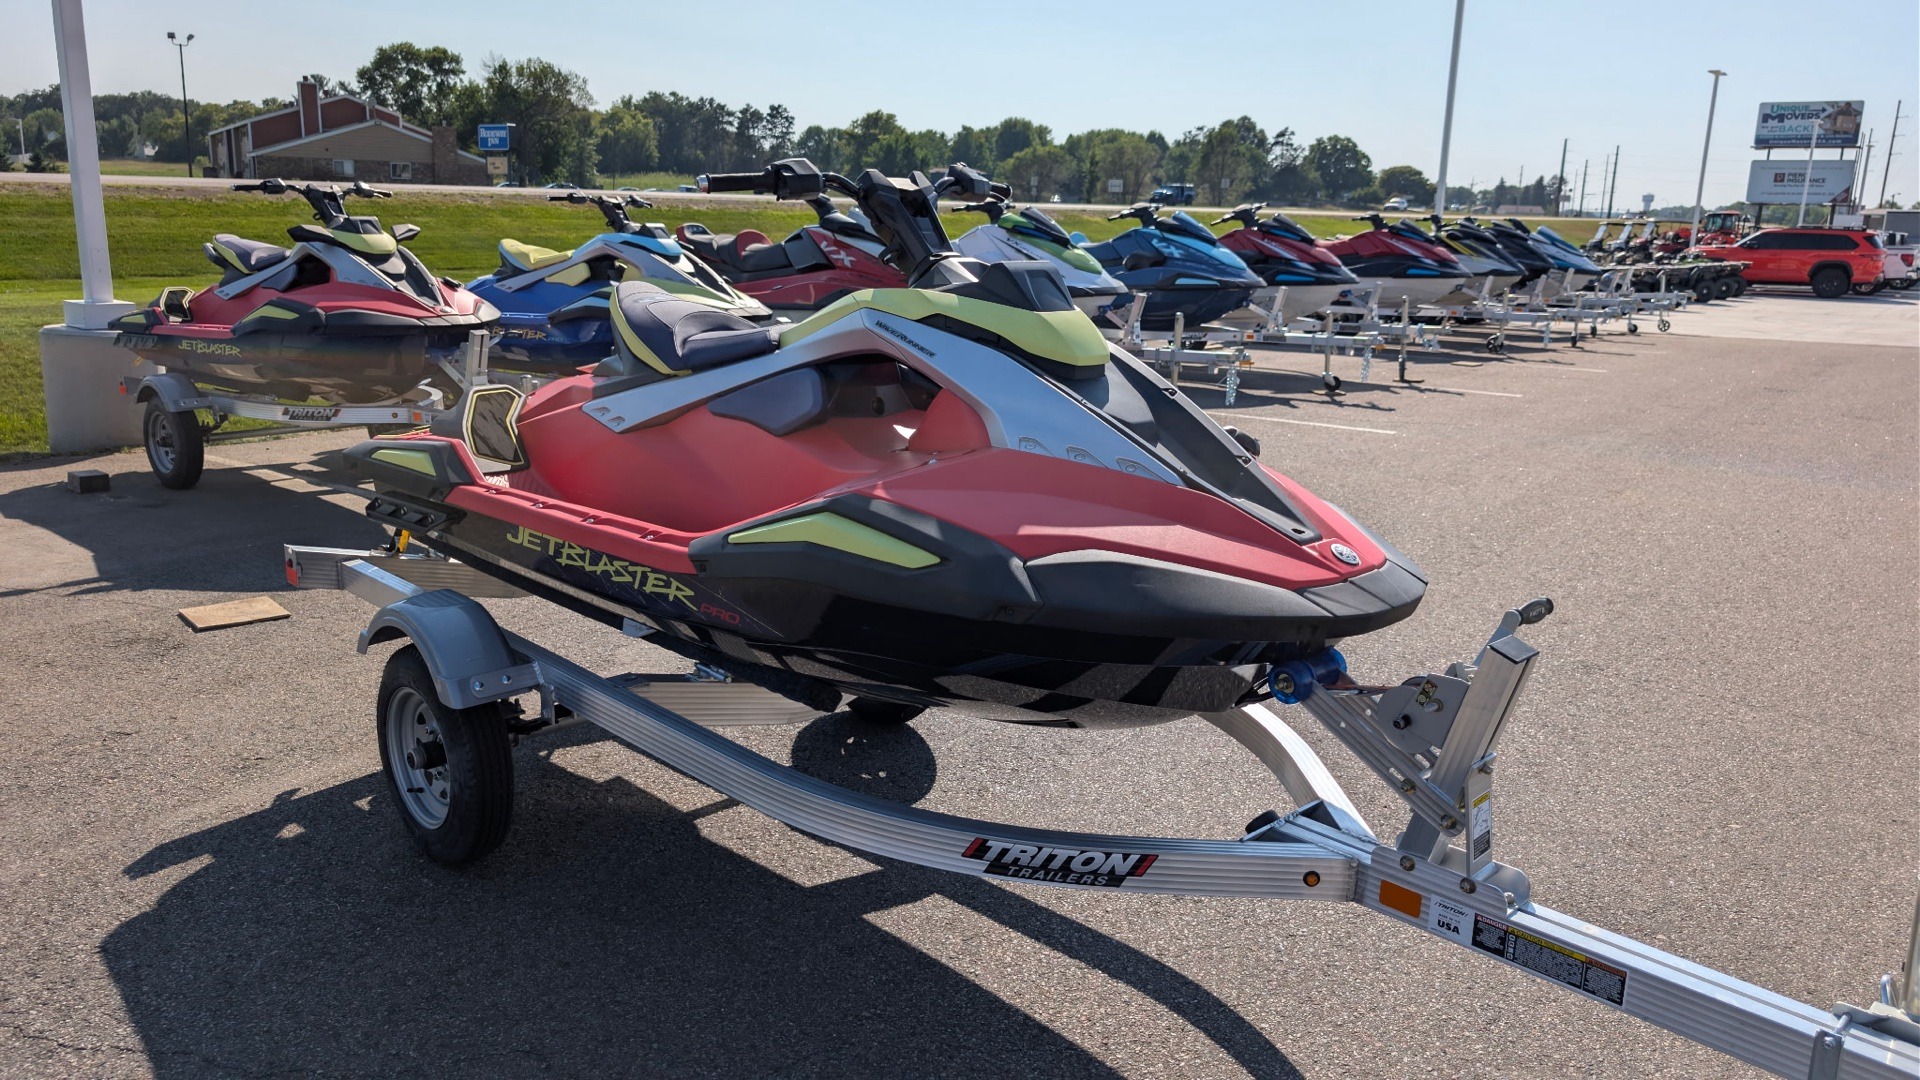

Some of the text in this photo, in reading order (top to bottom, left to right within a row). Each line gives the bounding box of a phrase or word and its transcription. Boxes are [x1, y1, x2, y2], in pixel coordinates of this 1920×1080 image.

[1762, 112, 1820, 123] MOVERS
[1771, 104, 1810, 114] UNIQUE
[820, 240, 857, 268] VX
[178, 339, 242, 357] JETBLASTER
[290, 408, 335, 417] TRITON
[506, 526, 741, 625] JETBLASTER PRO
[983, 840, 1141, 876] TRITON
[1008, 866, 1108, 886] TRAILERS
[1437, 919, 1460, 935] USA
[1482, 916, 1507, 931] DANGER
